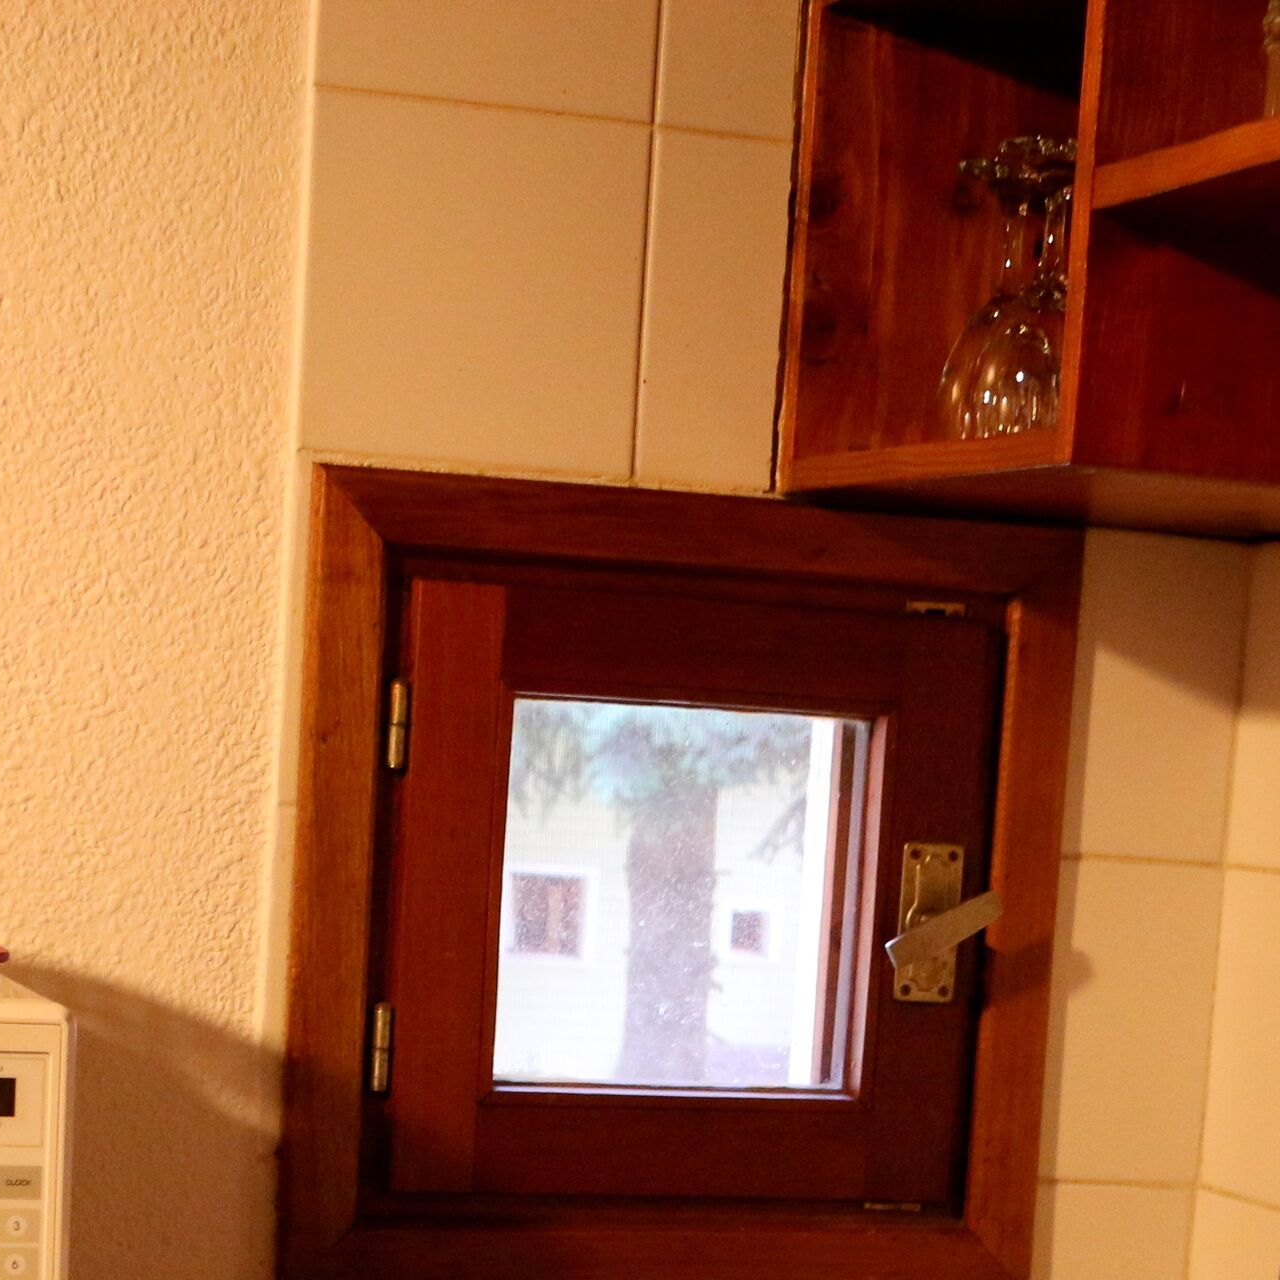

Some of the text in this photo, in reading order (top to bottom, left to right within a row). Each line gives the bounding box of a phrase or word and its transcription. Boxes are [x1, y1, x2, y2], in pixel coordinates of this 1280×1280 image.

[5, 1179, 32, 1187] CLOCK
[14, 1220, 21, 1231] 3
[11, 1260, 19, 1269] 6
